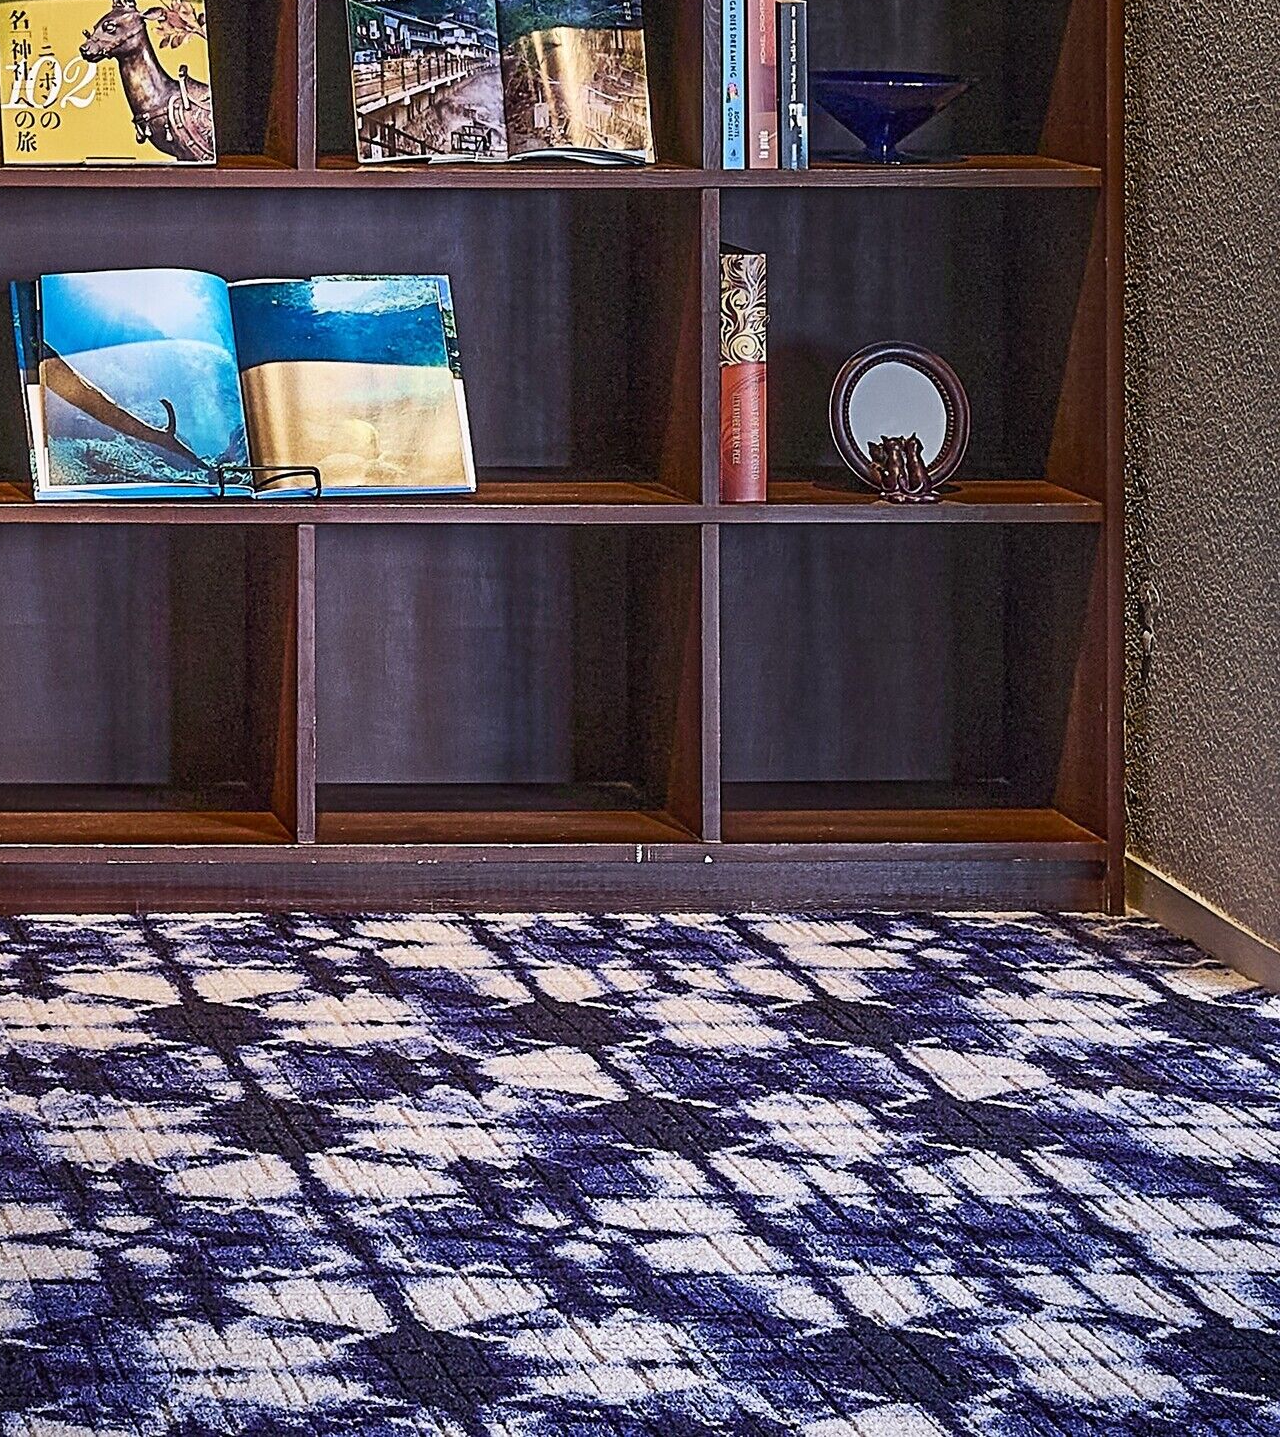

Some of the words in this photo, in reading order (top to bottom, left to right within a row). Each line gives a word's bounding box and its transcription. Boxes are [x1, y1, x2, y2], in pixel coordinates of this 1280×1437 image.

[729, 14, 737, 32] DIES
[730, 33, 738, 79] DREAMING
[38, 45, 61, 131] ニッポンの
